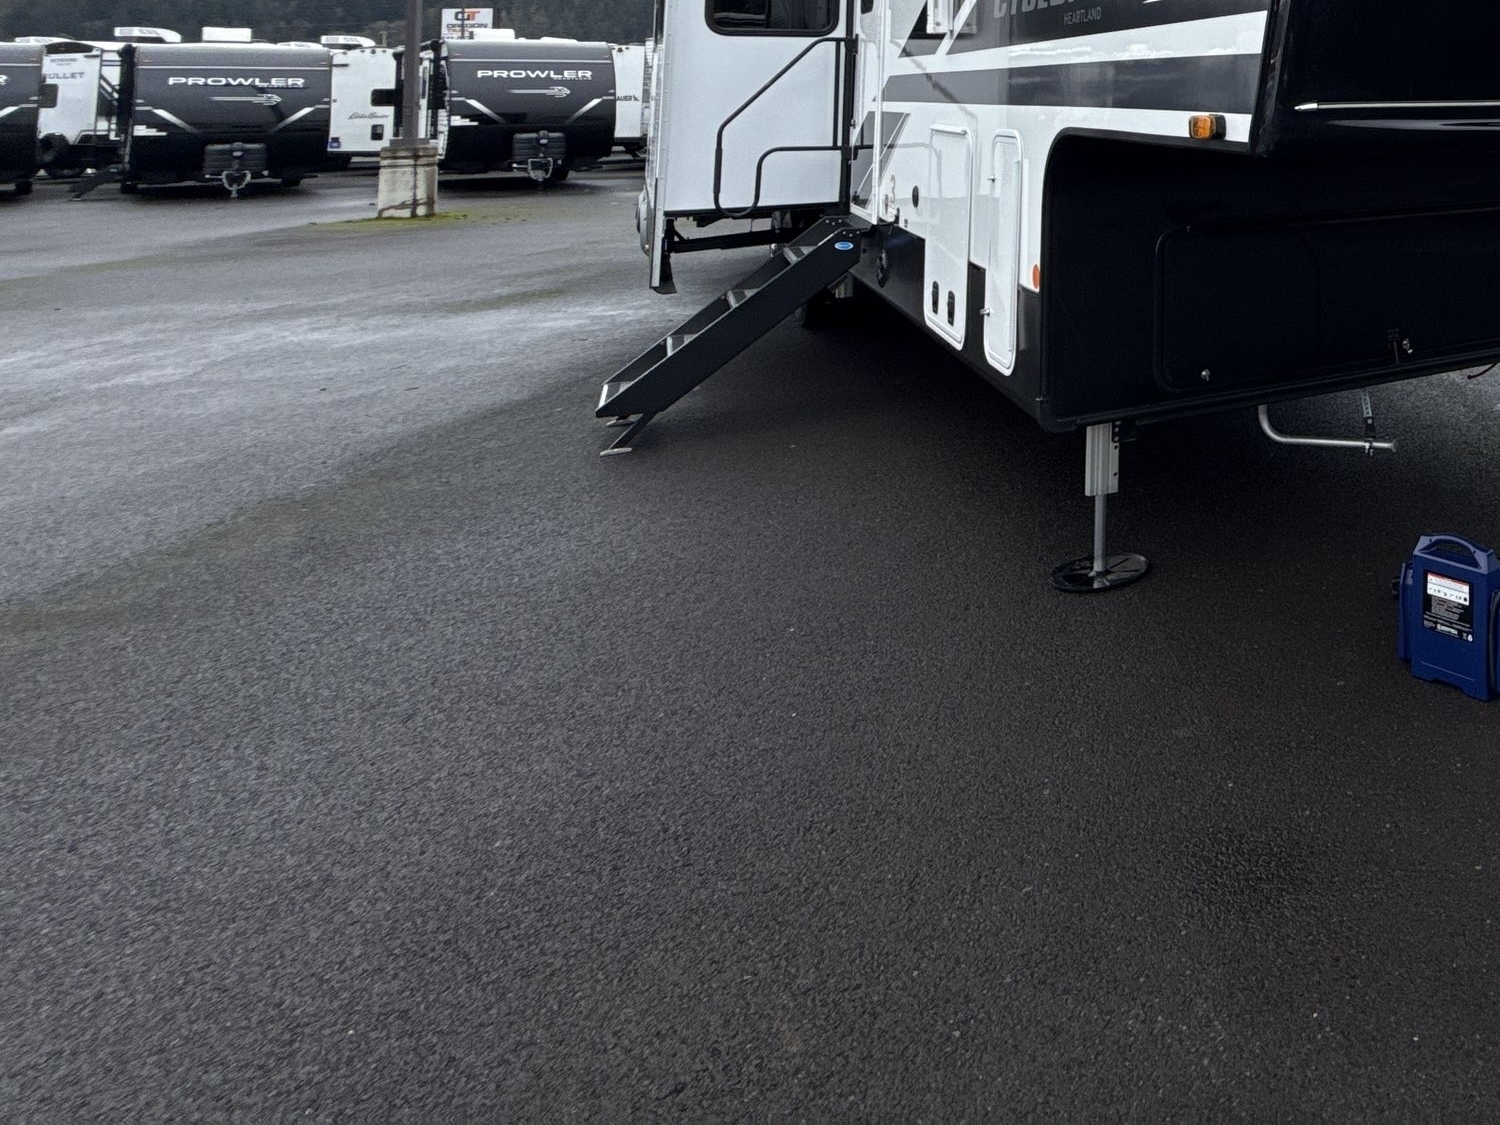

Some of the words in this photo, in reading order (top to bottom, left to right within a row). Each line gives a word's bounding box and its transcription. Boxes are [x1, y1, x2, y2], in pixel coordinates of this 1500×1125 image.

[1063, 7, 1102, 26] HEARTLAND
[477, 70, 593, 79] PROWLER
[168, 77, 305, 87] PROWLER
